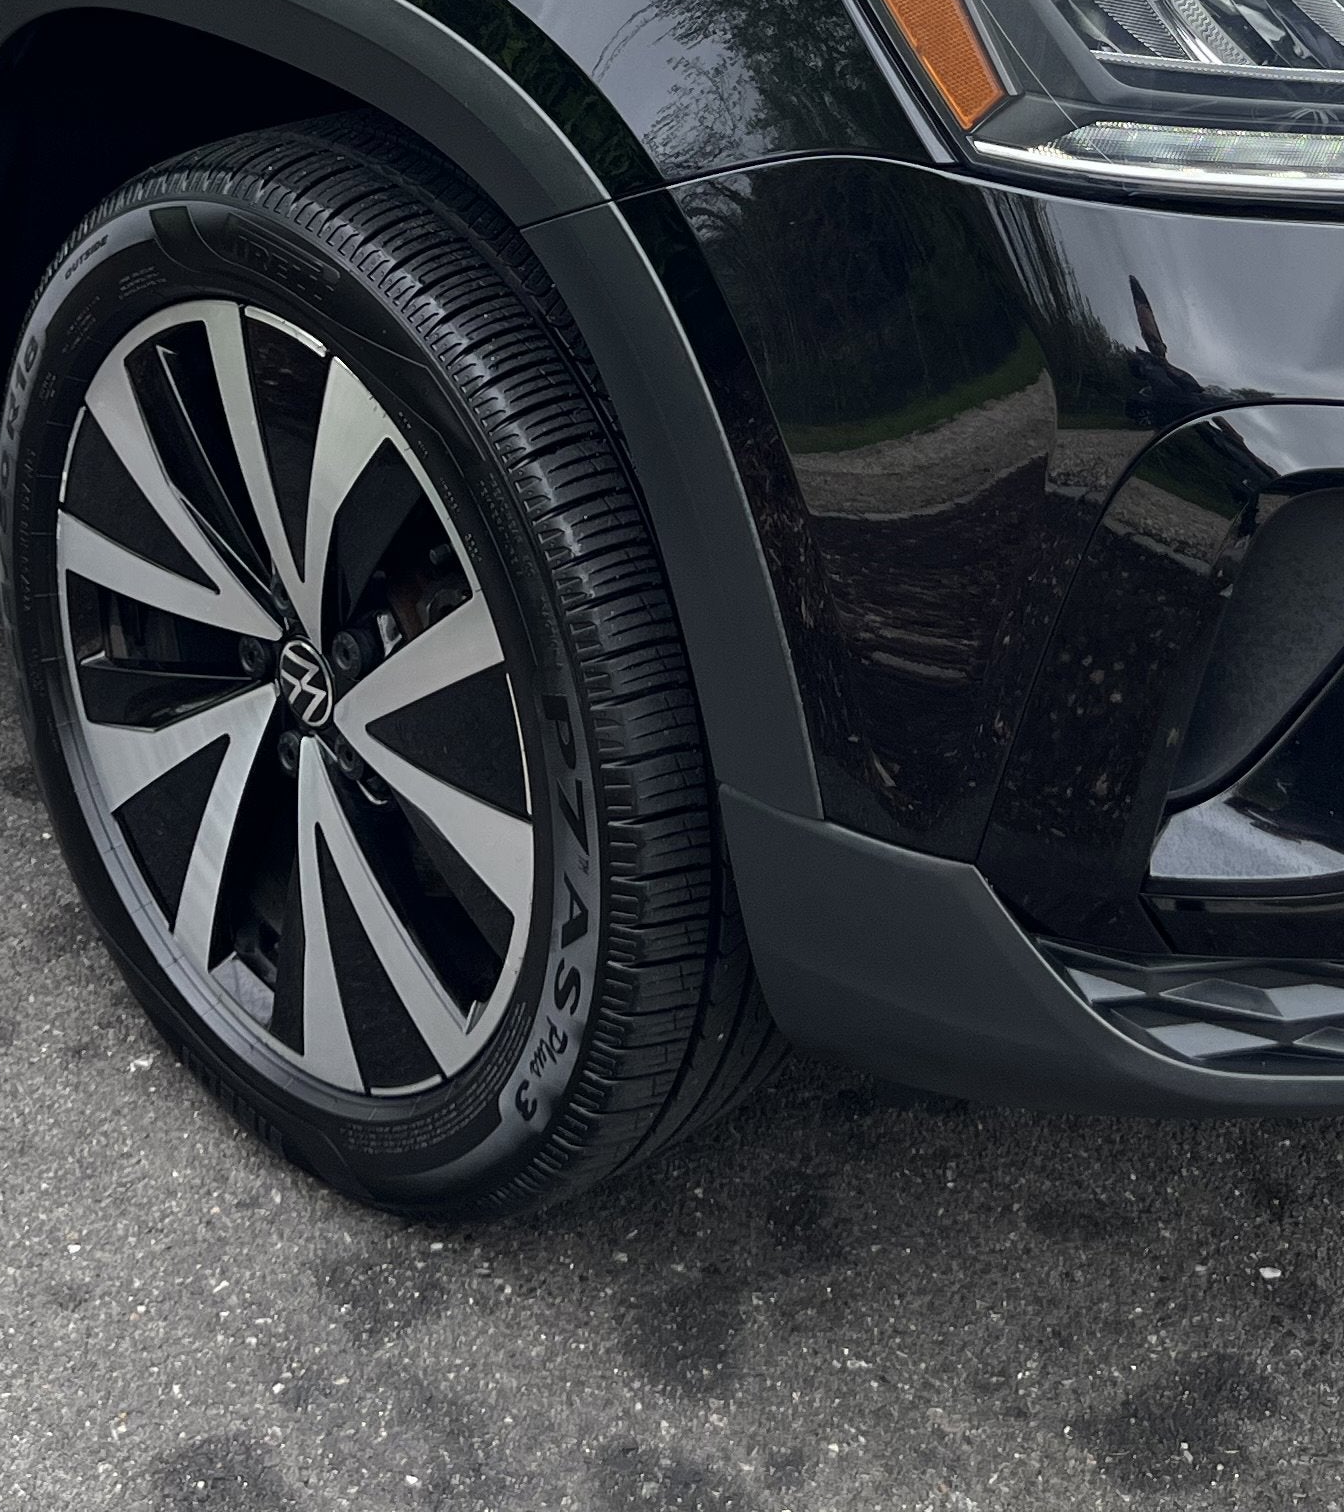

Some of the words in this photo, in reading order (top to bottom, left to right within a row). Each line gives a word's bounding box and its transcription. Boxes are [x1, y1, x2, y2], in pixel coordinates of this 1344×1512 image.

[64, 234, 109, 280] OUTSIDE
[529, 1015, 568, 1079] Plus
[515, 1079, 538, 1123] 3
